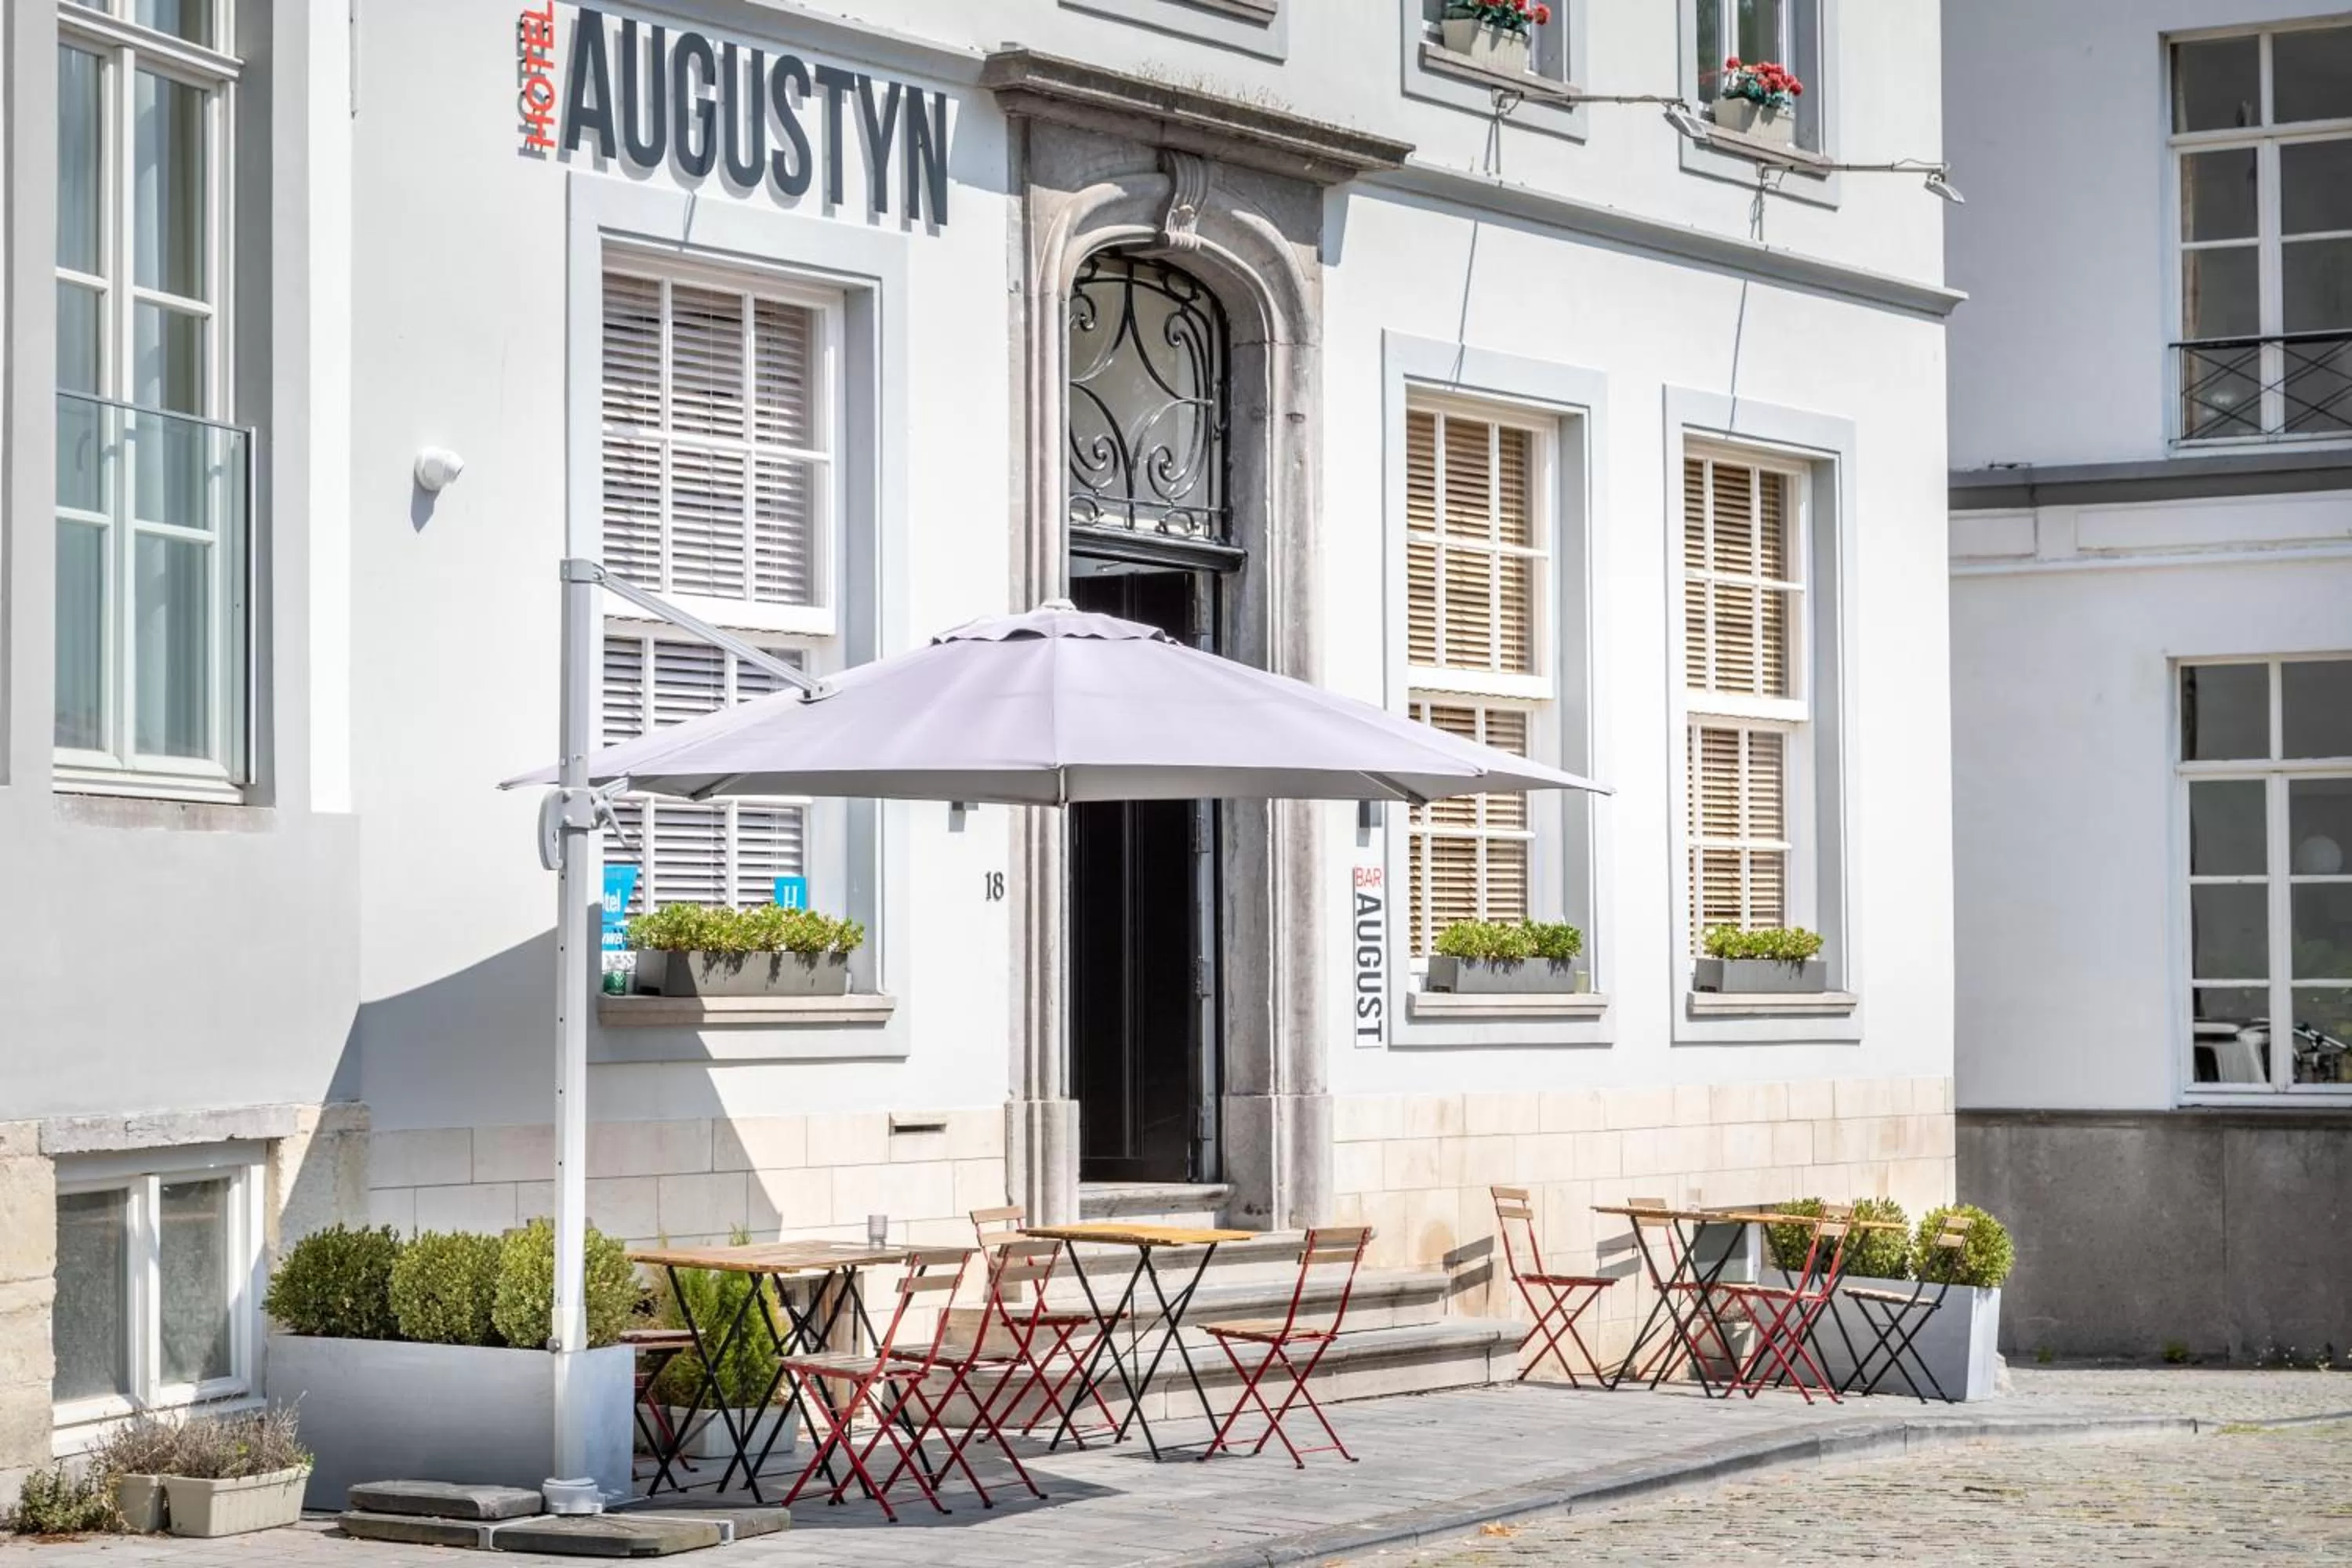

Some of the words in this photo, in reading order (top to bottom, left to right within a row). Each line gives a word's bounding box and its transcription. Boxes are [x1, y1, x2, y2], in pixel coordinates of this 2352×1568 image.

[524, 0, 555, 147] HOTEL
[564, 9, 947, 225] AUGUSTYN
[602, 888, 621, 913] tel
[985, 871, 1004, 902] 18
[1355, 867, 1381, 887] BAR
[1356, 892, 1382, 1042] AUGUST
